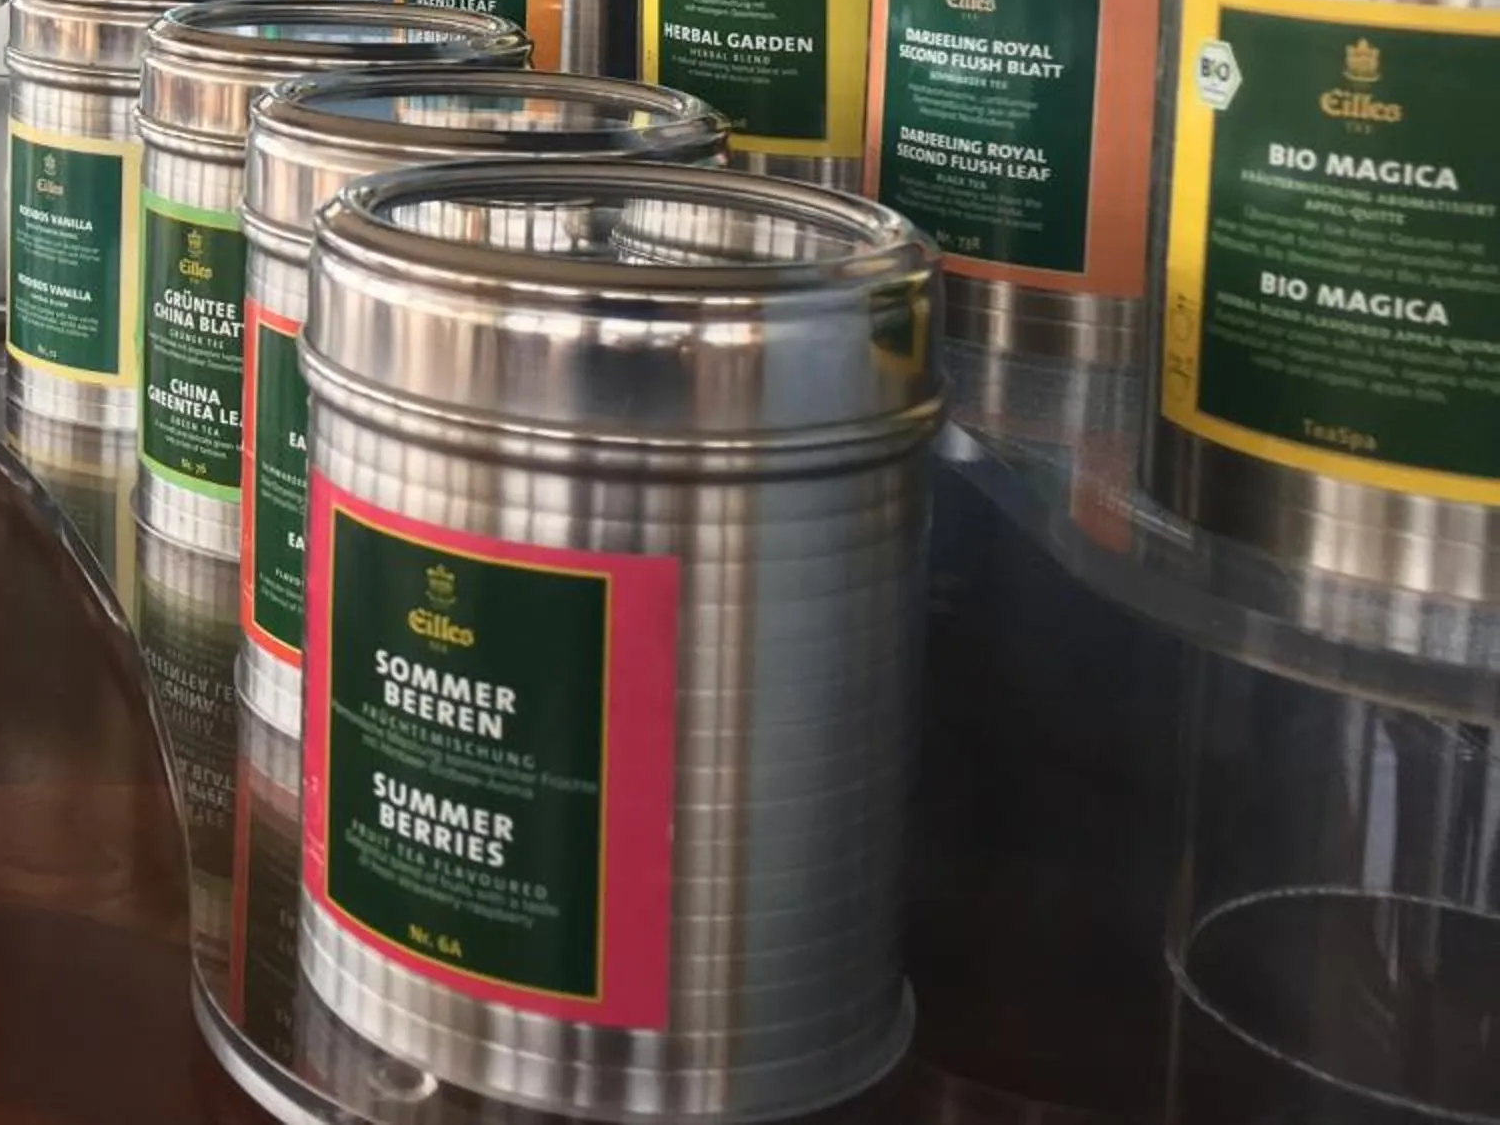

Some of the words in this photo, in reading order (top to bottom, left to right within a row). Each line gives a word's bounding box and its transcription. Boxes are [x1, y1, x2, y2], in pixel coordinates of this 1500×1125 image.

[664, 22, 722, 46] HERBAL
[727, 33, 813, 53] GARDEN
[905, 27, 988, 53] DARJEELING
[992, 40, 1052, 60] ROYAL
[899, 44, 948, 66] SECOND
[951, 53, 1001, 72] FLUSH
[1007, 60, 1065, 79] BLATT
[897, 143, 947, 167] SECOND
[950, 154, 1001, 176] FLUSH
[1007, 164, 1052, 182] LEAF
[900, 126, 983, 155] DARJEELING
[987, 145, 1047, 164] ROYAL
[1268, 143, 1317, 172] BIO
[1325, 153, 1459, 191] MAGICA
[50, 214, 93, 231] VANILLA
[49, 284, 92, 302] VANILLA
[164, 288, 236, 319] GRÜNTEE
[1260, 271, 1307, 301] BIO
[1316, 283, 1449, 326] MAGICA
[153, 302, 195, 329] CHINA
[148, 384, 214, 422] GREENTEA
[220, 408, 243, 427] LE
[170, 378, 221, 406] CHINA
[289, 431, 307, 451] EA
[1303, 418, 1378, 450] TeaSpa
[288, 531, 305, 551] EA
[375, 649, 517, 715] SOMMER
[384, 680, 503, 739] BEEREN
[362, 702, 536, 770] FRÜCHTEMISCHUNG
[372, 772, 515, 842] SUMMER
[379, 803, 505, 868] BERRIES
[397, 843, 425, 865] TEA
[433, 858, 548, 901] FLAVOURED
